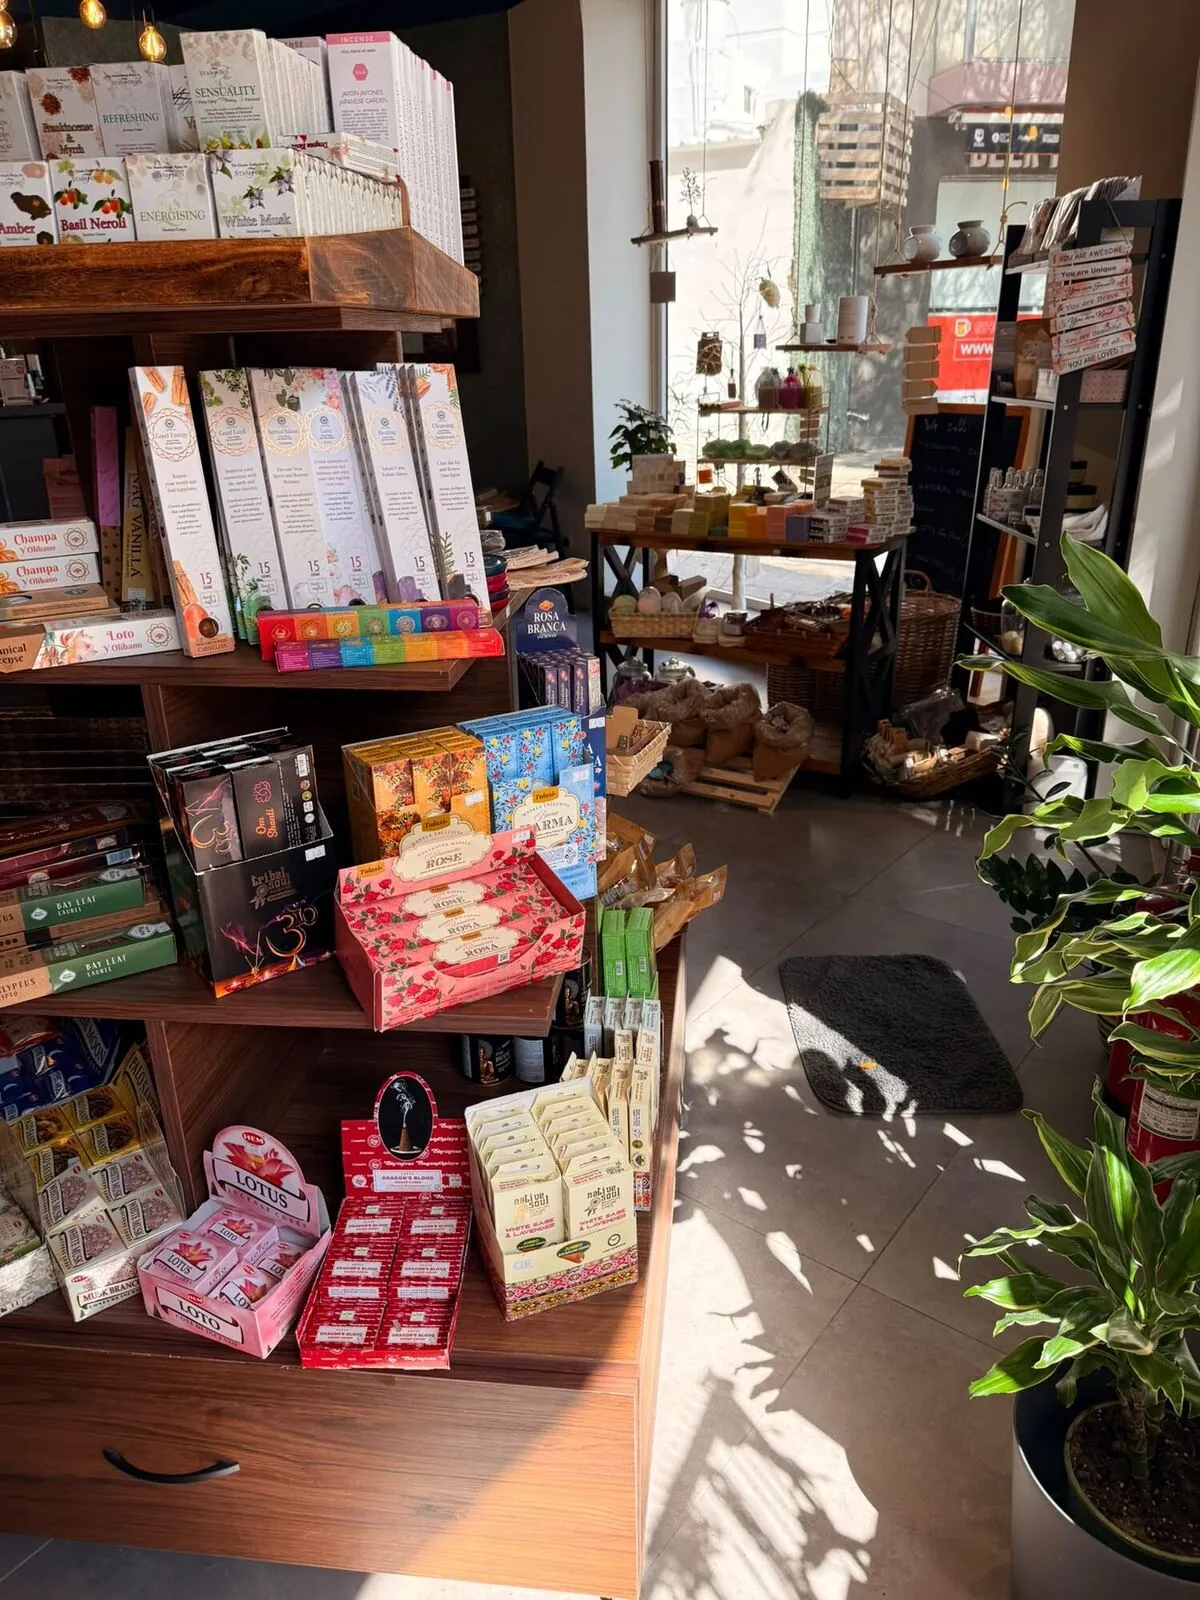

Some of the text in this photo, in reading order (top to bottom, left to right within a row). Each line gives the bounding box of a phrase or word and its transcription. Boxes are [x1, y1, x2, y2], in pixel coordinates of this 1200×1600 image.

[341, 35, 374, 43] INCENSE
[195, 85, 256, 98] SENSUALITY
[103, 112, 160, 124] REFRESHING
[42, 122, 94, 133] Frankincense
[66, 133, 75, 143] &
[59, 144, 85, 157] Myrrh
[140, 210, 206, 222] ENERGISING
[223, 212, 292, 228] White Musk
[0, 221, 35, 234] Amber
[61, 216, 127, 232] Basil Neroli
[1060, 254, 1073, 262] YOU
[1089, 246, 1123, 257] AWESOME
[1091, 265, 1117, 275] Unique
[1068, 347, 1119, 369] YOU ARE LOVED
[14, 532, 57, 546] Champa
[131, 514, 143, 578] VANILLA
[27, 545, 56, 554] Olibano
[350, 556, 362, 568] 15
[414, 556, 425, 568] 15
[464, 552, 475, 564] 15
[16, 564, 60, 577] Champa
[259, 561, 271, 574] 15
[308, 560, 320, 572] 15
[29, 577, 58, 586] Olibano
[200, 572, 213, 585] 15
[534, 611, 559, 622] ROSA
[527, 621, 566, 634] BRANCA
[106, 630, 135, 641] Loto
[112, 642, 143, 652] Olibano
[256, 817, 266, 835] Om
[266, 808, 278, 838] Shanti
[535, 815, 573, 831] ARMA
[425, 853, 463, 869] ROSE
[251, 866, 286, 887] tribal
[56, 895, 97, 910] BAY LEAF
[433, 896, 465, 909] ROSE
[58, 906, 82, 917] LAUREL
[447, 921, 481, 935] ROSA
[465, 943, 499, 957] ROSA
[85, 954, 128, 971] BAY LEAF
[87, 967, 113, 978] LAUREL
[128, 1056, 145, 1083] PALO
[243, 1133, 265, 1144] HEM
[236, 1170, 288, 1209] LOTUS
[587, 1185, 616, 1199] native
[601, 1187, 621, 1201] soul
[514, 1192, 545, 1206] native
[528, 1195, 549, 1209] soul
[579, 1208, 626, 1225] WHITE SAGE
[586, 1213, 627, 1229] LAVENDER
[505, 1217, 554, 1233] WHITE SAGE
[513, 1222, 555, 1237] LAVENDER
[220, 1228, 238, 1241] LOTO
[167, 1255, 193, 1275] LOTUS
[83, 1286, 108, 1302] MUSK
[178, 1300, 220, 1330] LOTO
